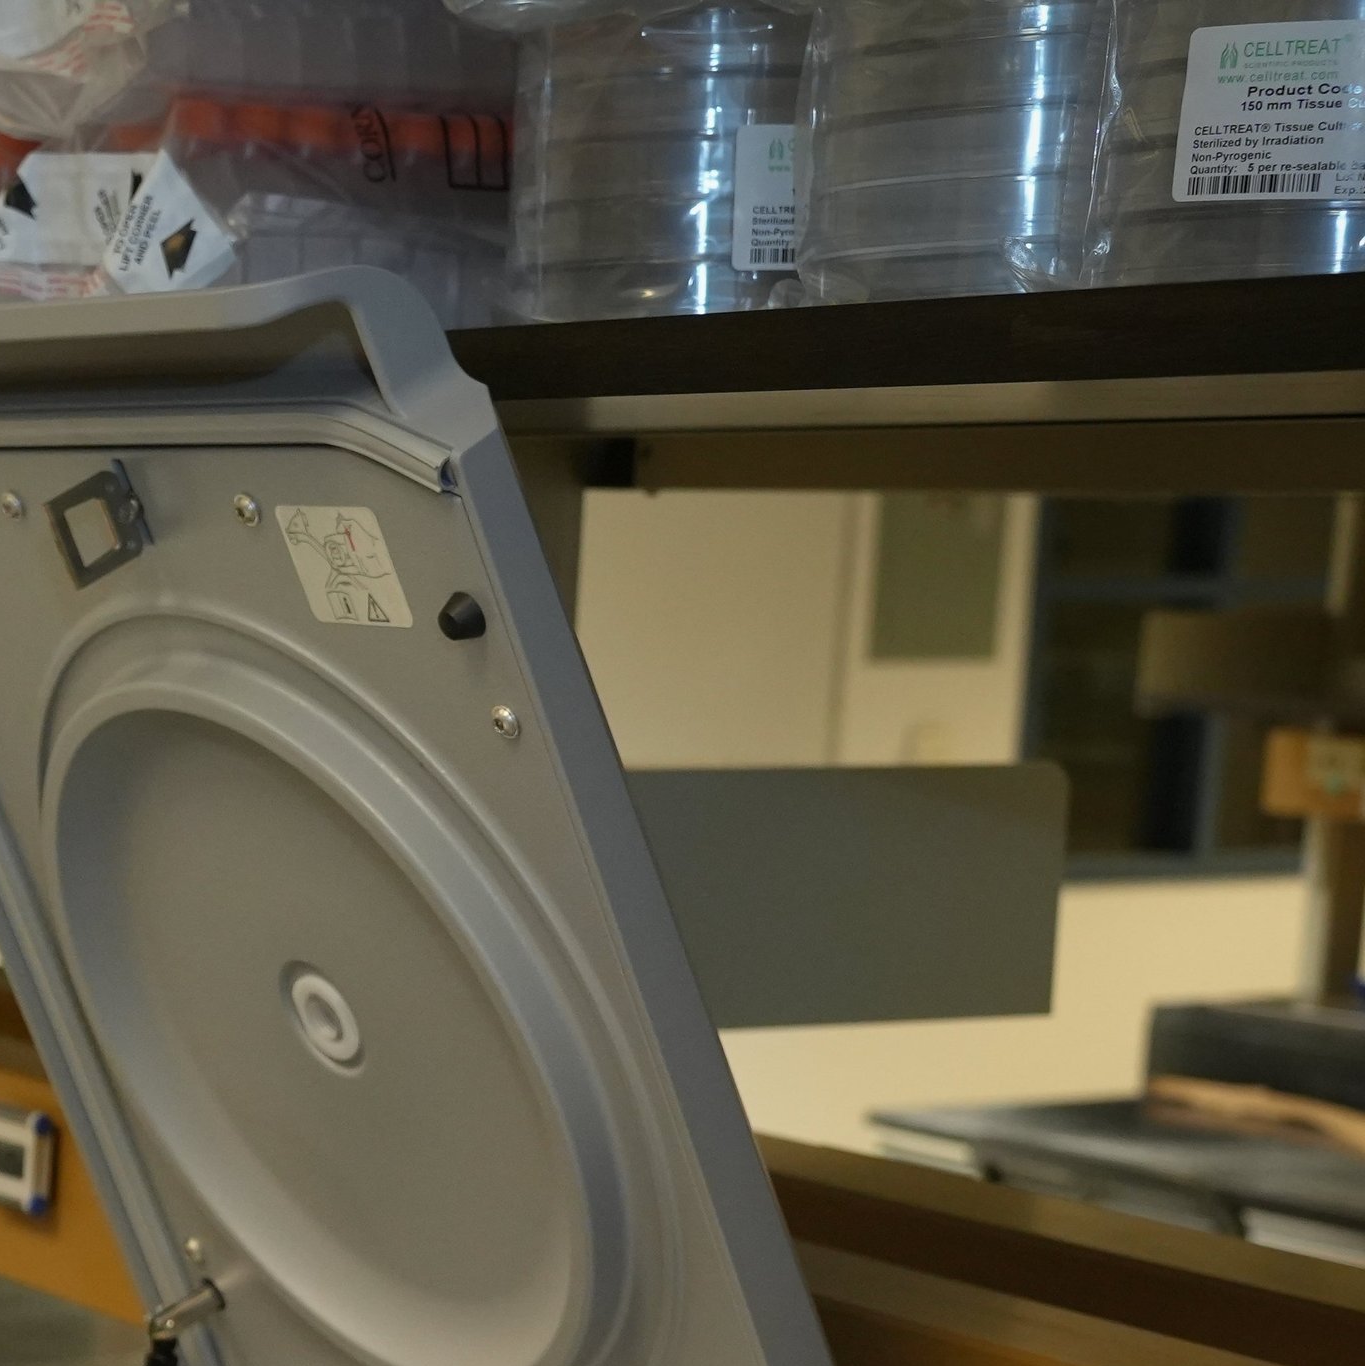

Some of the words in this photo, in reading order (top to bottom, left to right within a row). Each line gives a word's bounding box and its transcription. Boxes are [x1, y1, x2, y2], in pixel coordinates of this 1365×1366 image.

[1244, 38, 1341, 58] CELLTREAT
[1247, 84, 1313, 98] Product
[1240, 101, 1263, 111] 150
[1267, 101, 1291, 110] mm
[1297, 98, 1343, 109] Tissue
[1274, 121, 1314, 132] Tissue
[1193, 138, 1242, 149] Sterilized
[1245, 138, 1258, 148] by
[1262, 135, 1324, 146] Irradiation
[1191, 151, 1272, 163] Non-Pyrogenic
[1190, 164, 1238, 176] Quantity:
[1248, 163, 1255, 172] 5
[1257, 163, 1277, 174] per
[752, 228, 795, 237] Non-Pyro
